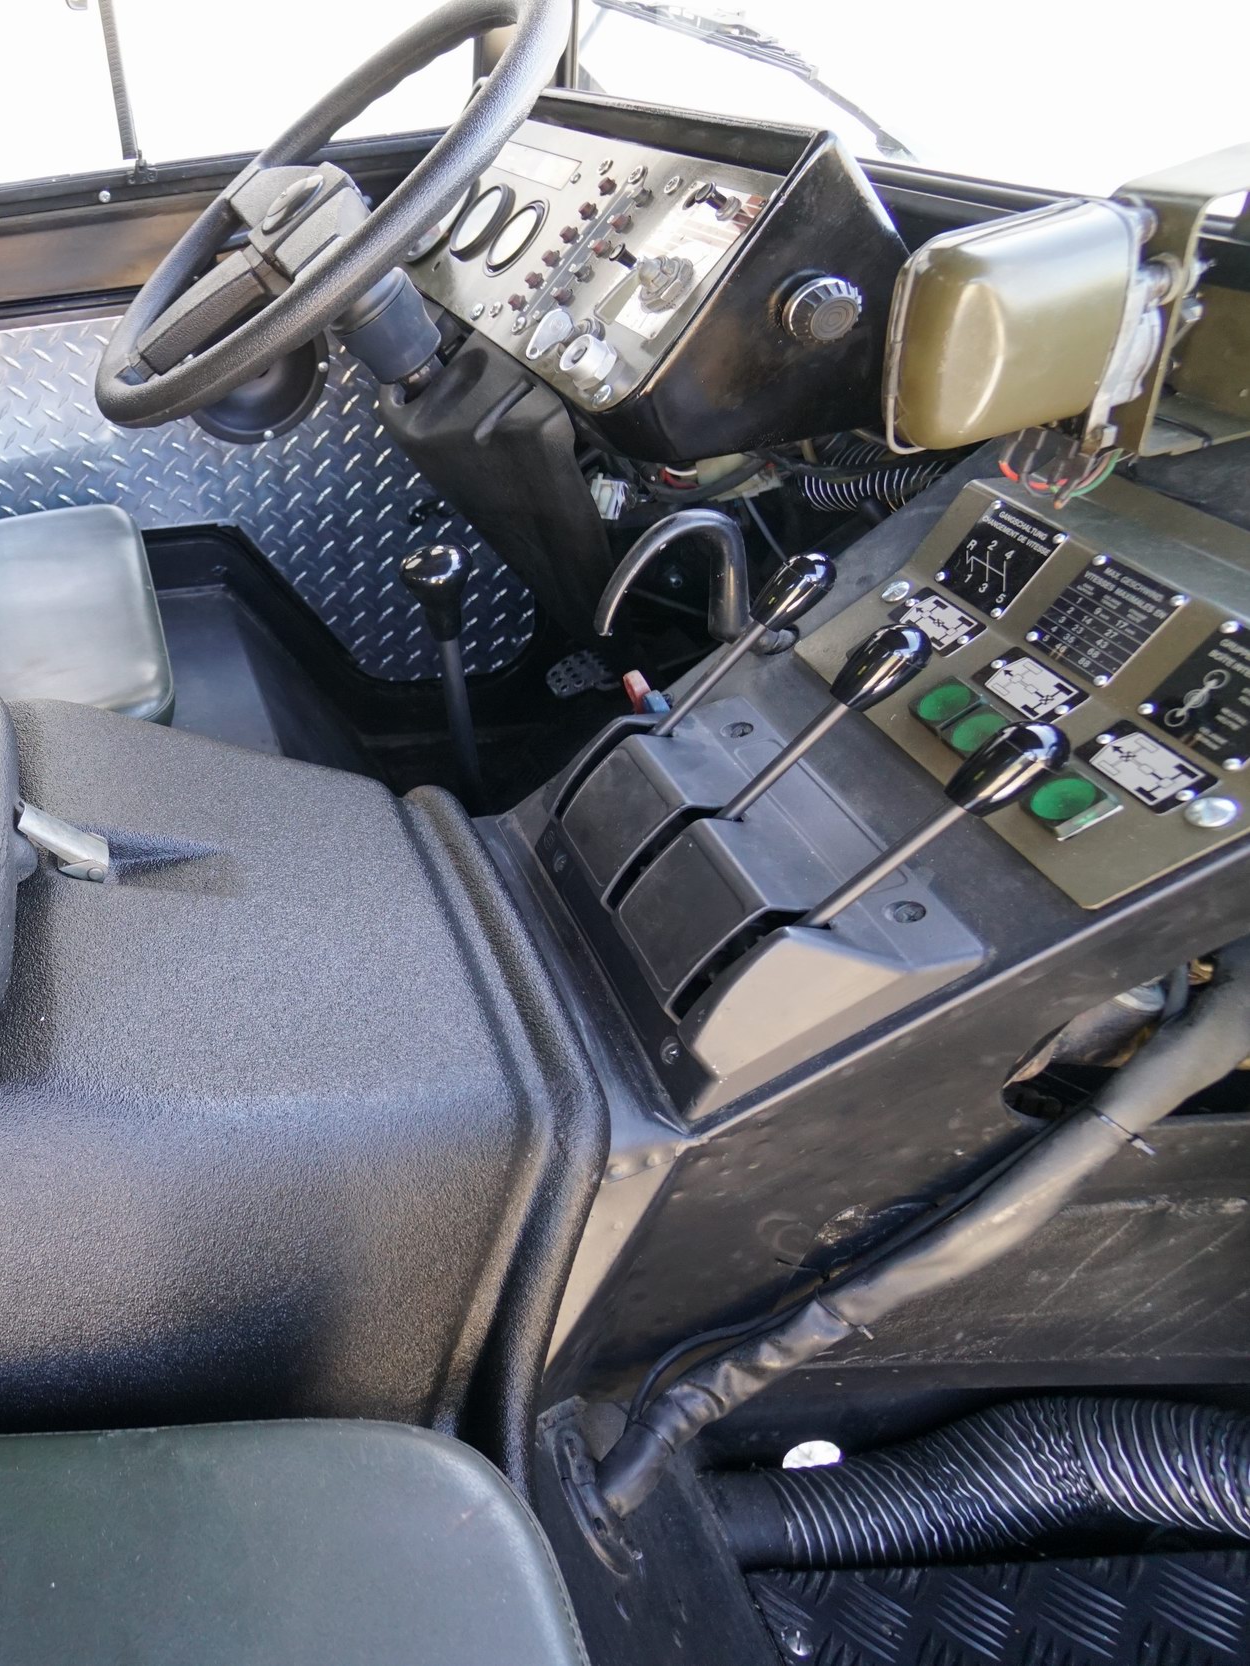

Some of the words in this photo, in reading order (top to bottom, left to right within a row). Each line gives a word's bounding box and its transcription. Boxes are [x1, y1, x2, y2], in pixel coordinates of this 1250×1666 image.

[982, 515, 1020, 540] CHANGEMENT
[1017, 534, 1028, 543] DE
[1025, 539, 1051, 556] VITESSE
[999, 511, 1048, 541] GANGSCHALTUNG
[967, 539, 978, 551] R
[987, 540, 998, 551] 2
[1004, 550, 1016, 560] 4
[964, 573, 973, 583] 1
[978, 582, 989, 593] 3
[995, 593, 1006, 604] 5
[1066, 606, 1075, 615] 2
[1081, 615, 1093, 625] 14
[1104, 629, 1119, 639] 27
[1076, 597, 1083, 605] 1
[1115, 620, 1129, 629] 17
[1042, 634, 1050, 642] 5
[1058, 616, 1067, 624] 3
[1071, 624, 1084, 635] 23
[1095, 639, 1109, 649] 43
[1062, 633, 1076, 644] 35
